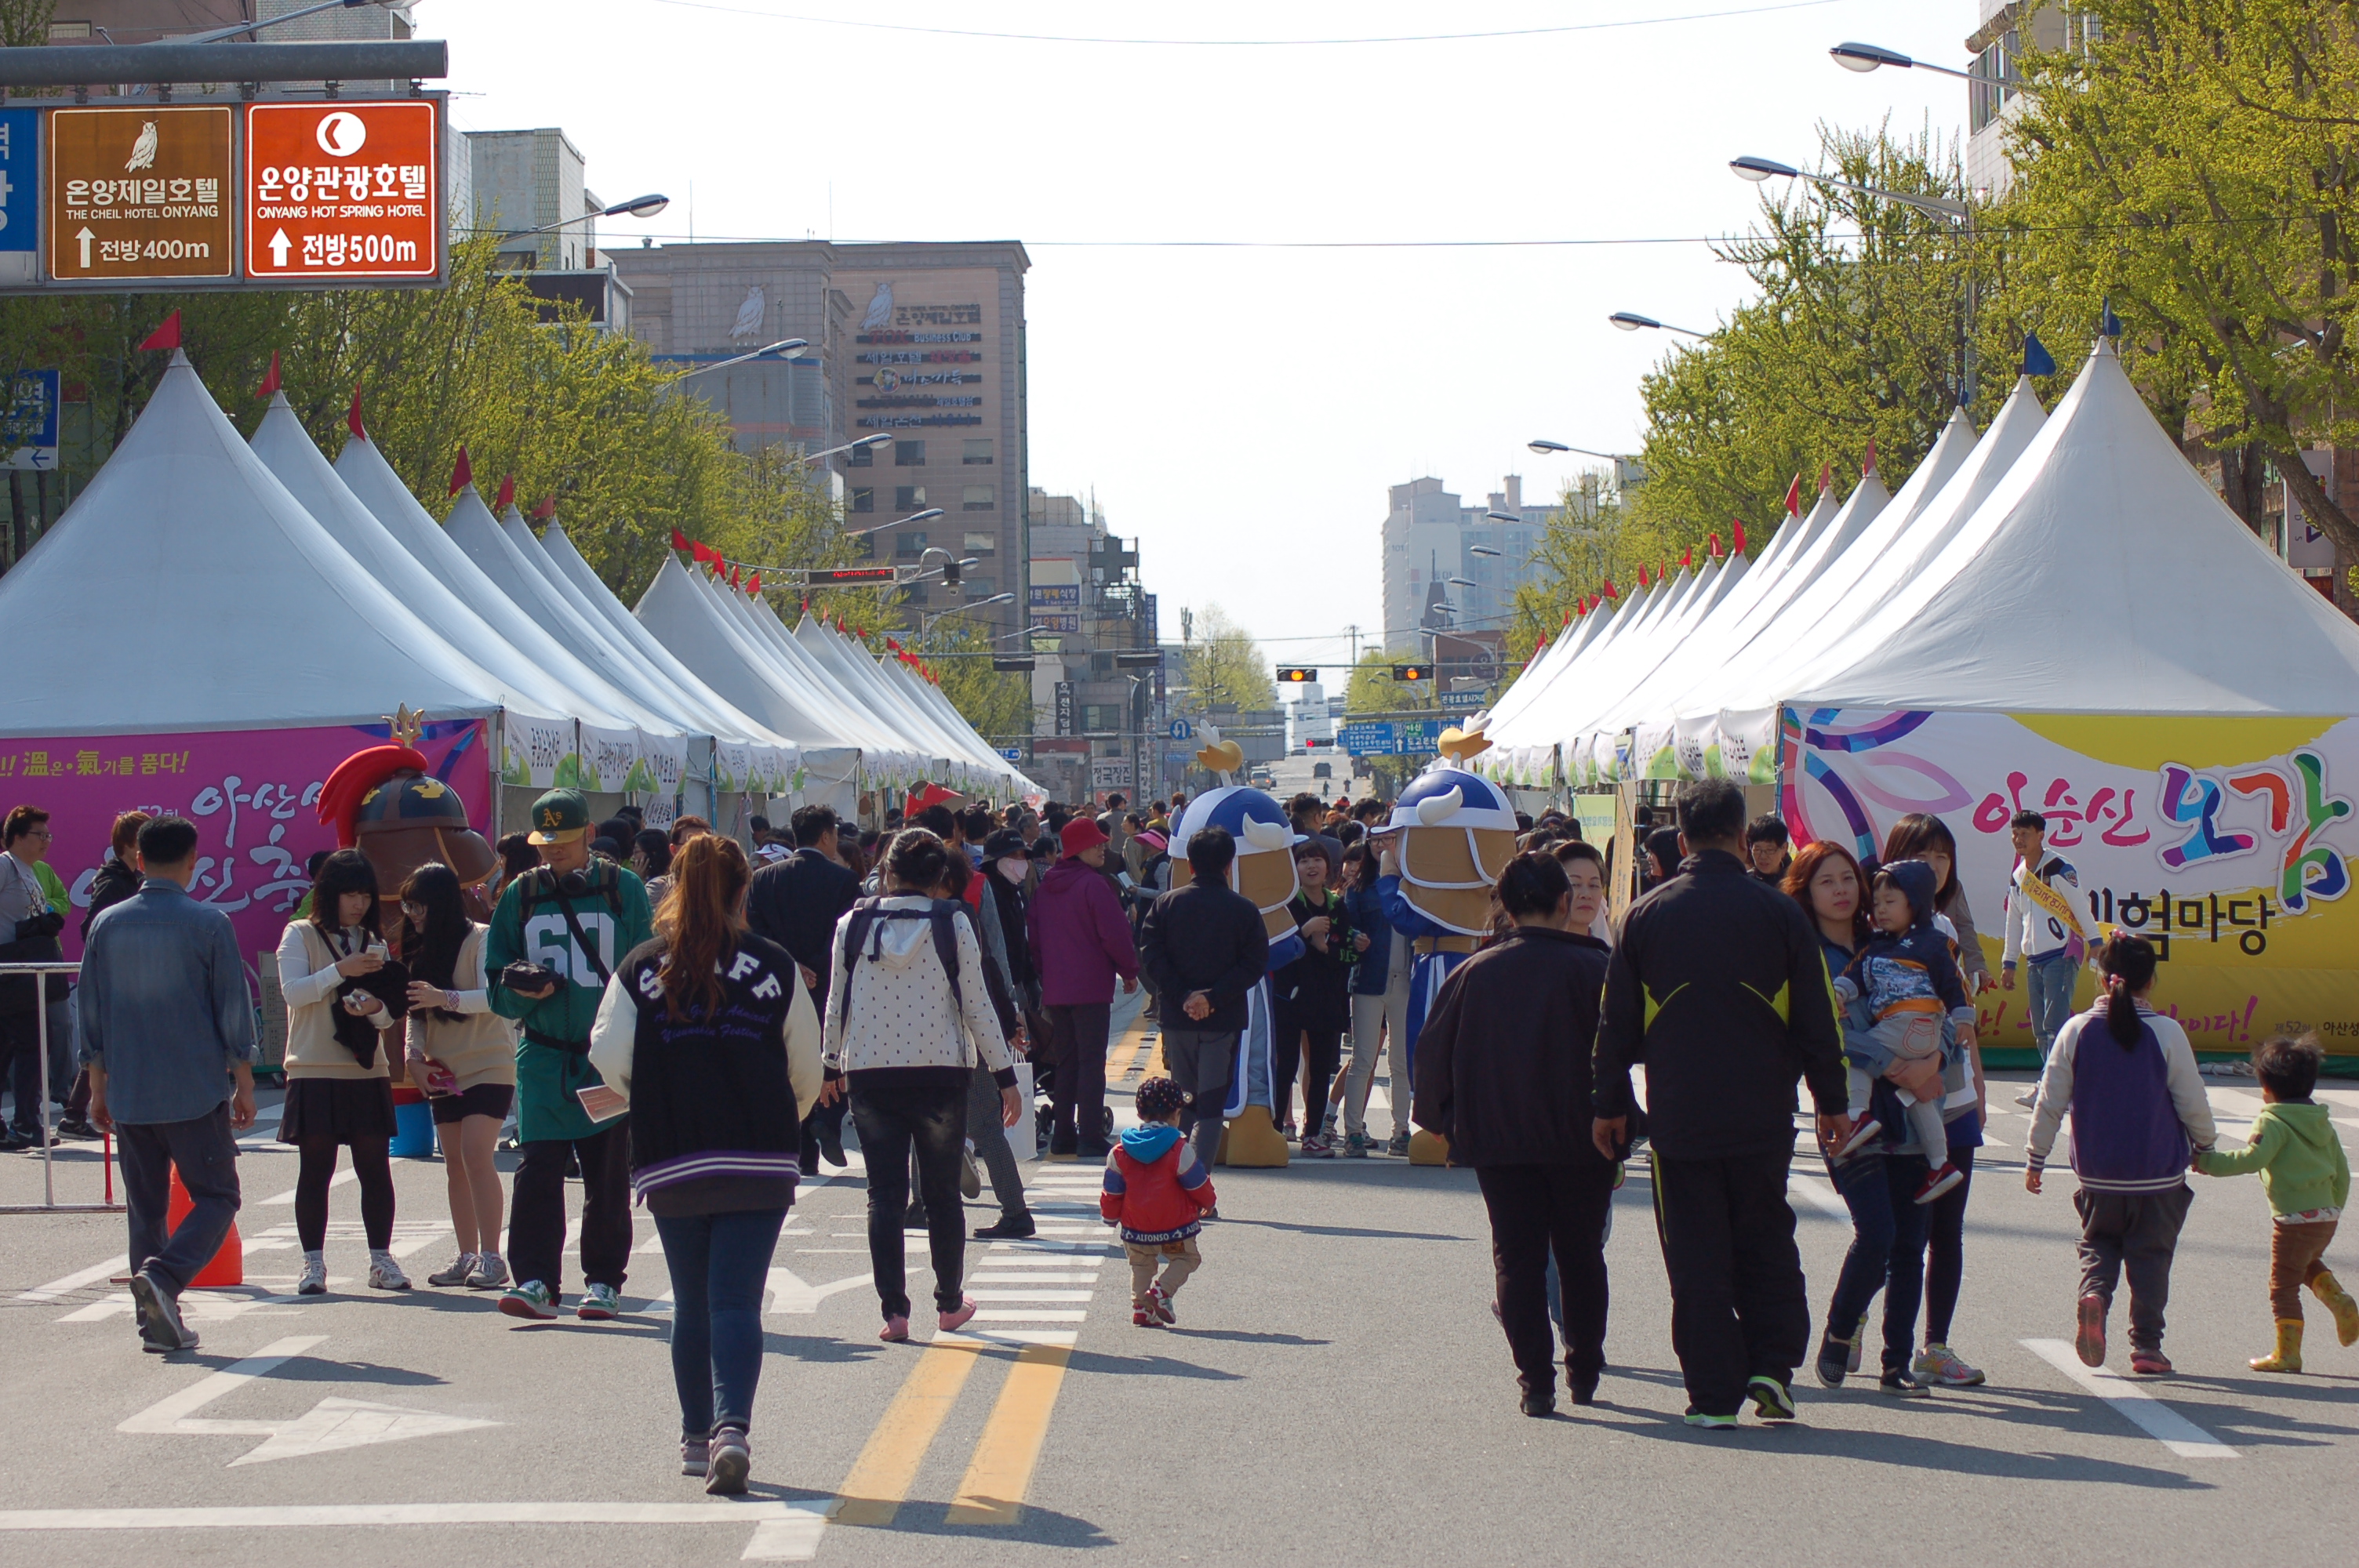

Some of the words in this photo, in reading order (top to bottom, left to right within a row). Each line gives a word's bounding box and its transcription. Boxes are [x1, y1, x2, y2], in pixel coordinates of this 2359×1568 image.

[66, 178, 218, 205] 온양제일호텔
[257, 163, 426, 201] 온양관광호텔
[66, 209, 88, 220] THE
[90, 209, 122, 220] CHEIL
[125, 209, 160, 219] HOTEL
[162, 205, 219, 218] ONYANG
[256, 206, 308, 219] ONYANG
[311, 205, 337, 218] HOT
[340, 205, 384, 218] SPRING
[387, 205, 426, 217] HOTEL
[302, 234, 416, 266] 전방500m
[869, 329, 909, 345] FOX
[914, 332, 951, 343] Business
[953, 331, 971, 343] Club
[866, 352, 921, 365] 제일호텔
[140, 750, 190, 775] 품다!
[525, 913, 614, 987] 60
[640, 951, 782, 1000] SFF
[1136, 1233, 1169, 1243] ALFONSO
